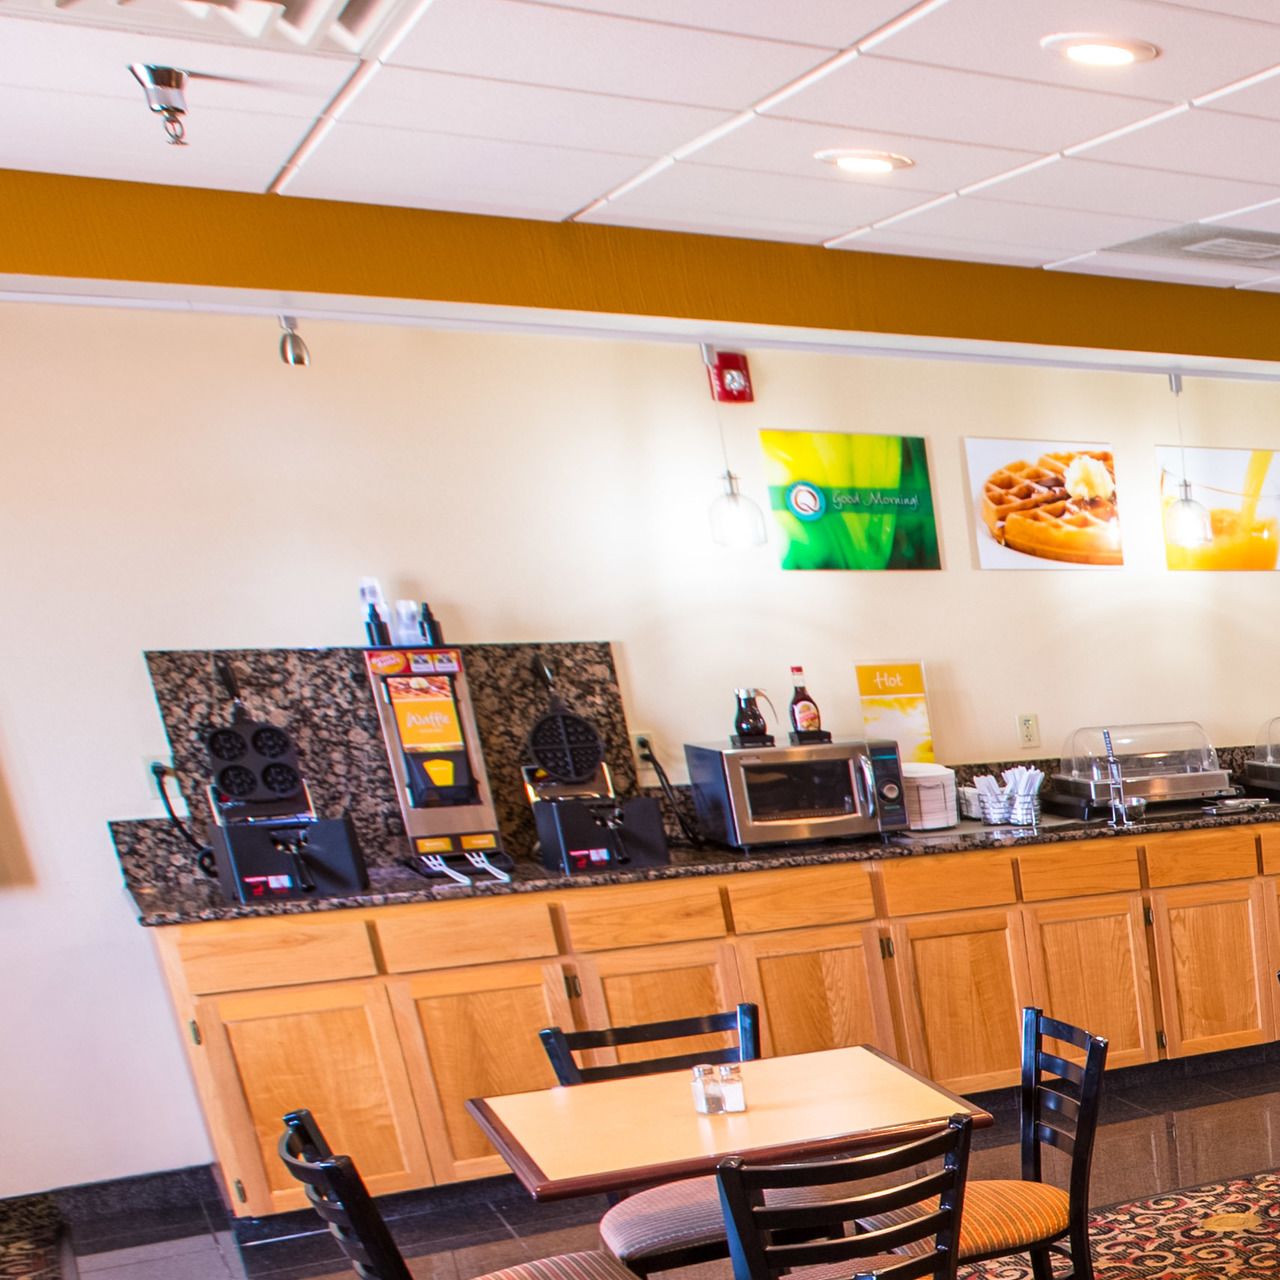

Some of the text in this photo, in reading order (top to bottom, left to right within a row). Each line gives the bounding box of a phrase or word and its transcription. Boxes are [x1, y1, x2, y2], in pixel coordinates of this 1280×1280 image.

[832, 491, 919, 511] Good Morning!
[874, 671, 904, 689] Hot
